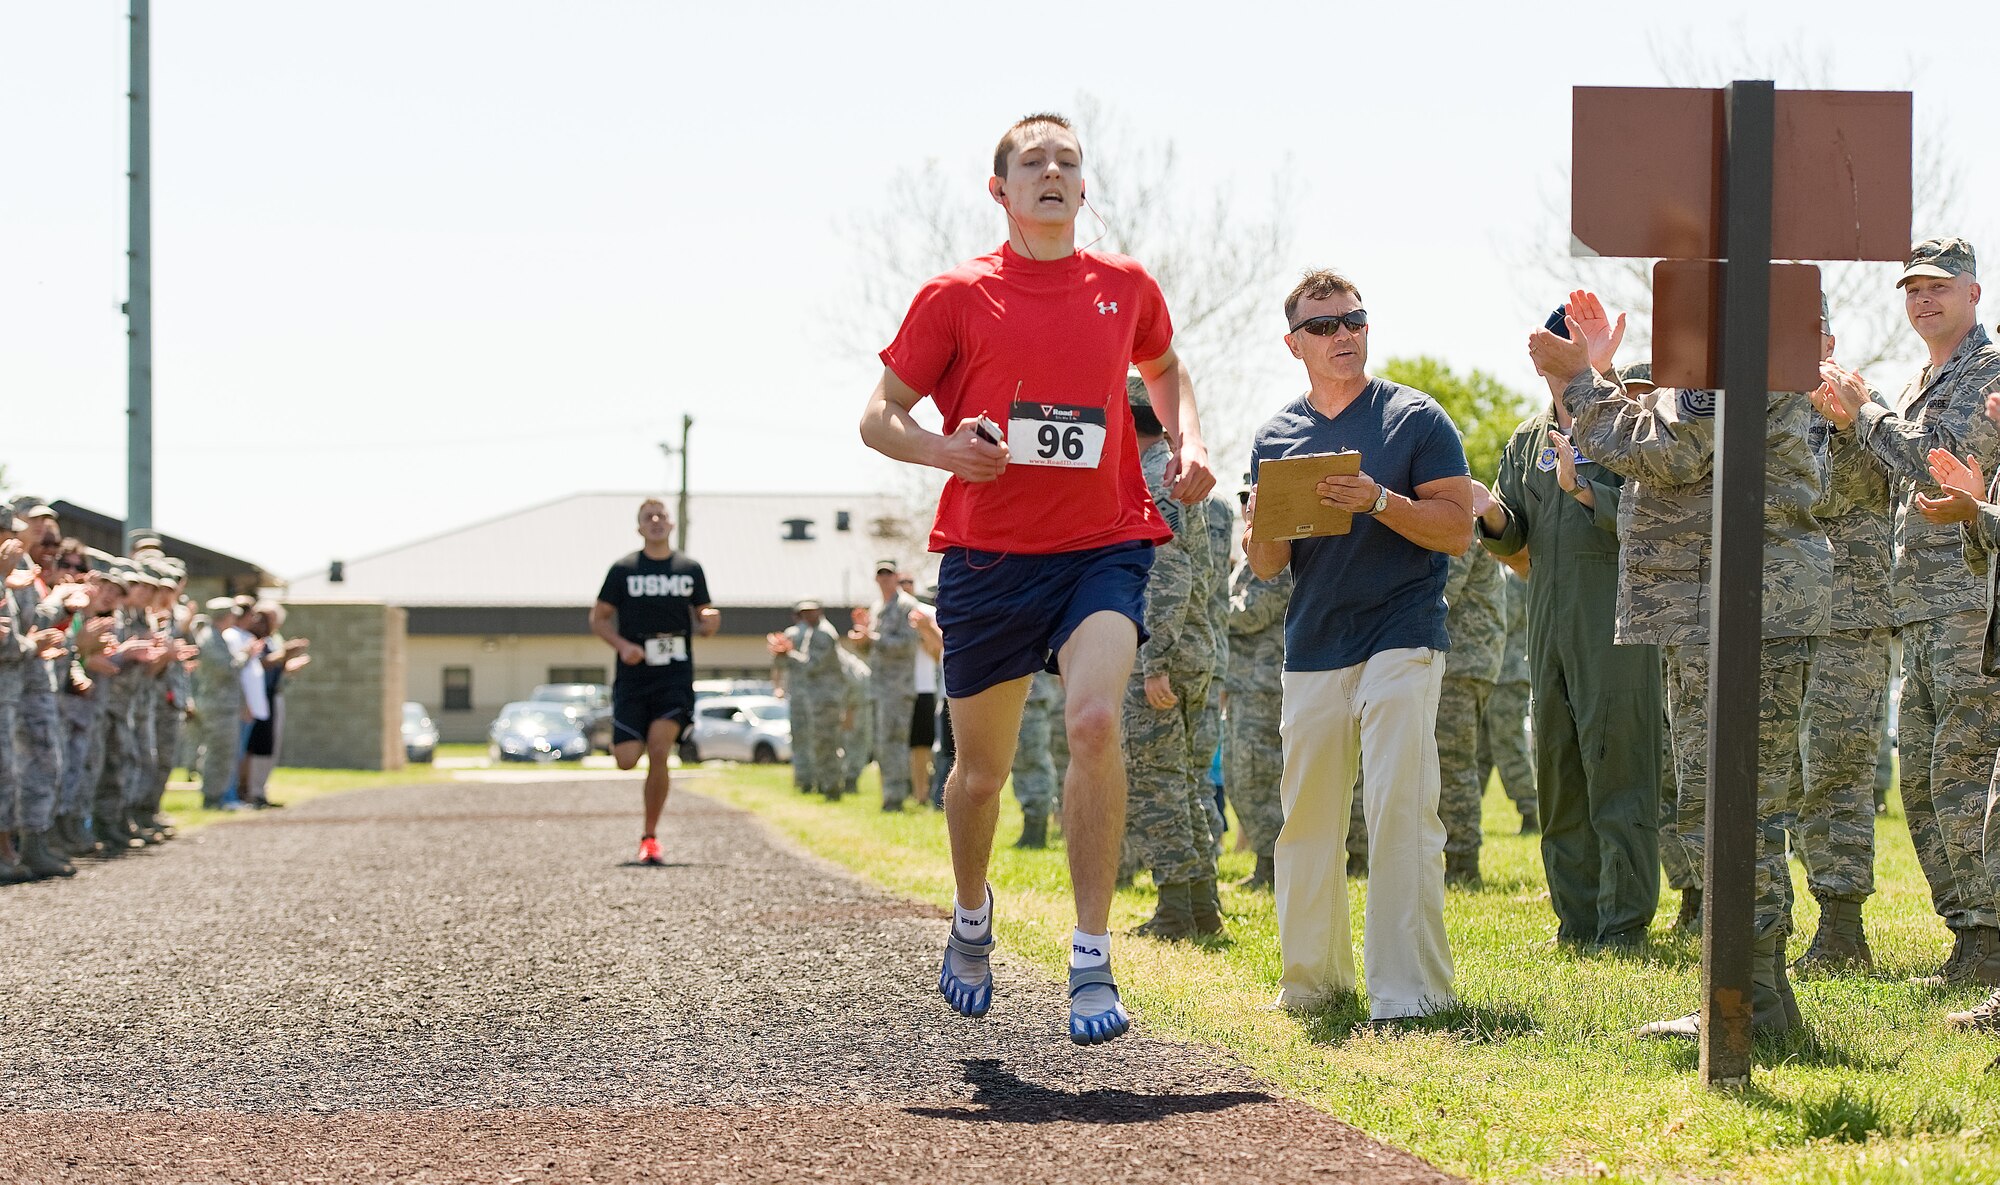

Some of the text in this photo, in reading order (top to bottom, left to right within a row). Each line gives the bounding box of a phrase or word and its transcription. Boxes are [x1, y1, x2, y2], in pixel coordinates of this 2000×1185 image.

[1037, 424, 1084, 461] 96
[1029, 459, 1088, 467] www.RoadID.com
[626, 574, 694, 598] USMC
[961, 915, 987, 926] FILA
[1072, 944, 1102, 957] FILA
